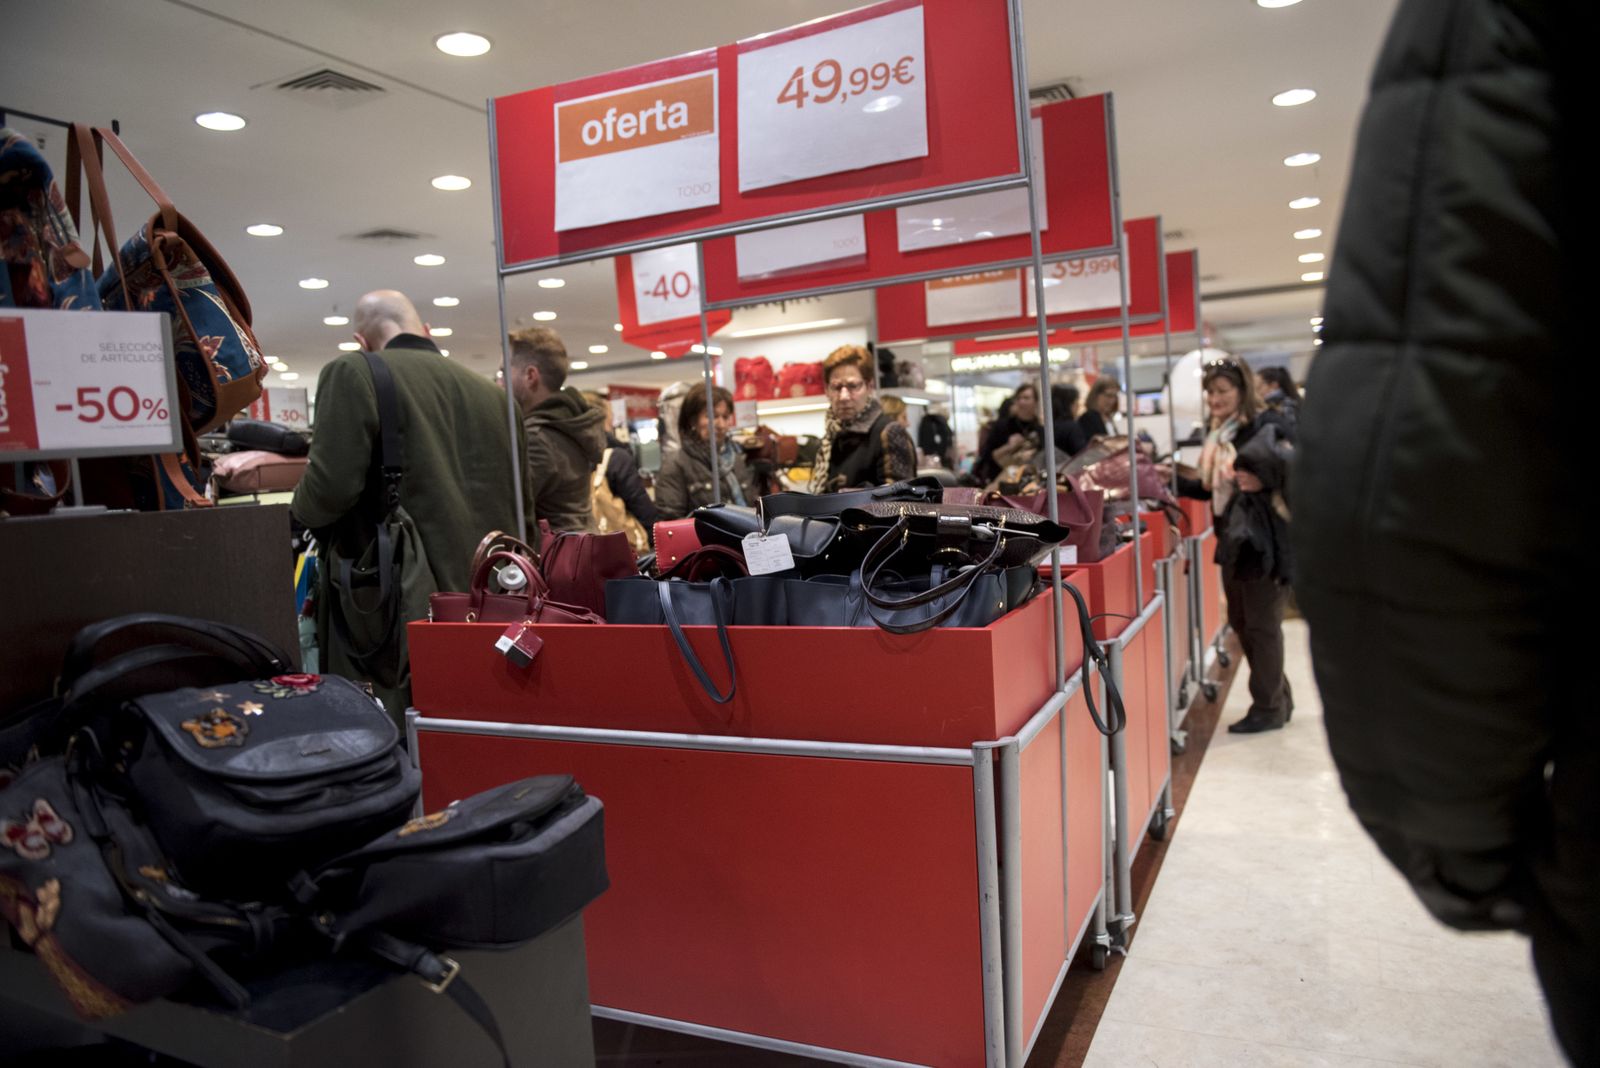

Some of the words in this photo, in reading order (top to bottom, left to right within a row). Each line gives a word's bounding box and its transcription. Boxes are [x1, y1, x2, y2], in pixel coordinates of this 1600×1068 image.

[777, 55, 915, 109] 49,99€
[581, 99, 688, 146] oferta
[678, 182, 711, 198] TODO
[81, 354, 97, 364] DE
[55, 385, 168, 423] -50%
